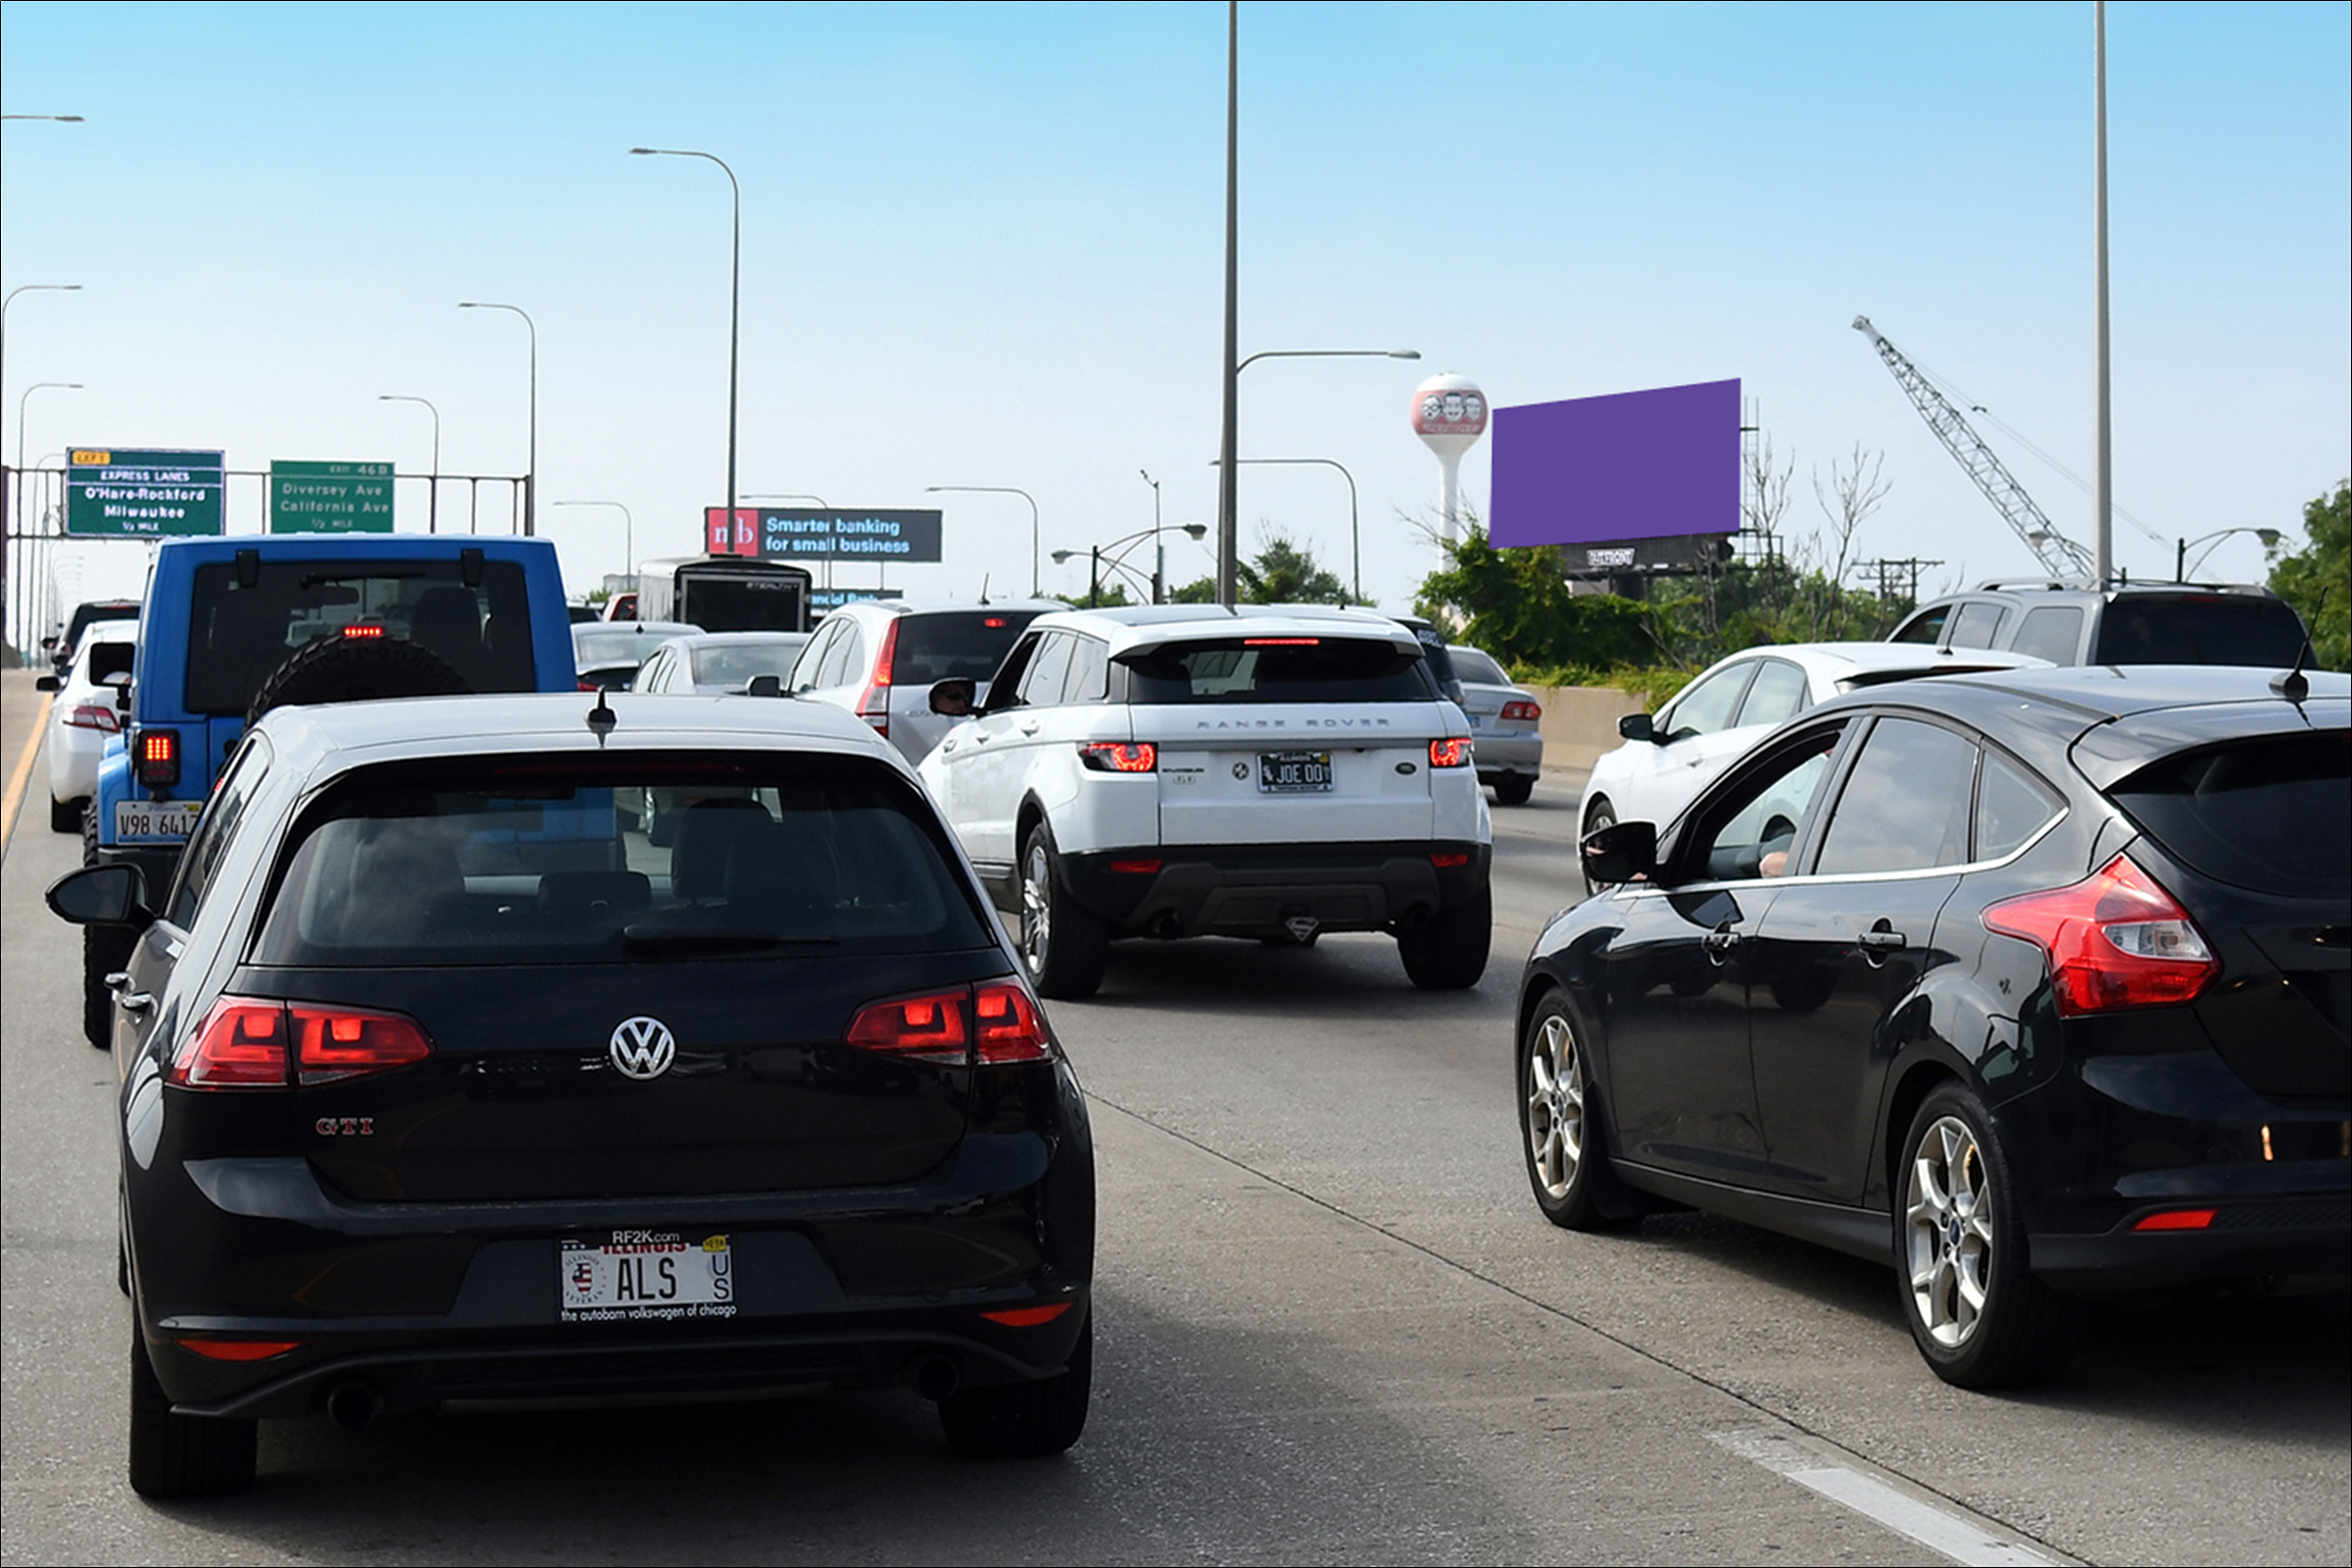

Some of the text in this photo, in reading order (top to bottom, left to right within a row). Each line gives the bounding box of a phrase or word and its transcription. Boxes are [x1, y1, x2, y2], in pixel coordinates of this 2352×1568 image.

[101, 470, 190, 481] EXPRESS LANES
[357, 465, 388, 475] 46B
[84, 487, 206, 501] O'Hare-Rockford
[282, 483, 382, 498] Diversey Ave
[104, 505, 185, 518] Milwaukee
[280, 500, 389, 514] California Ave
[766, 516, 901, 536] Smarter banking
[765, 535, 789, 552] for
[841, 539, 909, 554] business
[1198, 718, 1390, 729] RANGE ROVER
[1276, 764, 1301, 783] JOE
[121, 814, 150, 835] V98
[317, 1118, 373, 1135] GTI
[612, 1230, 680, 1244] RF2K.com
[617, 1256, 676, 1300] ALS
[562, 1310, 577, 1321] the
[629, 1305, 685, 1320] volkswagen
[687, 1303, 697, 1316] of
[700, 1303, 737, 1317] chicago
